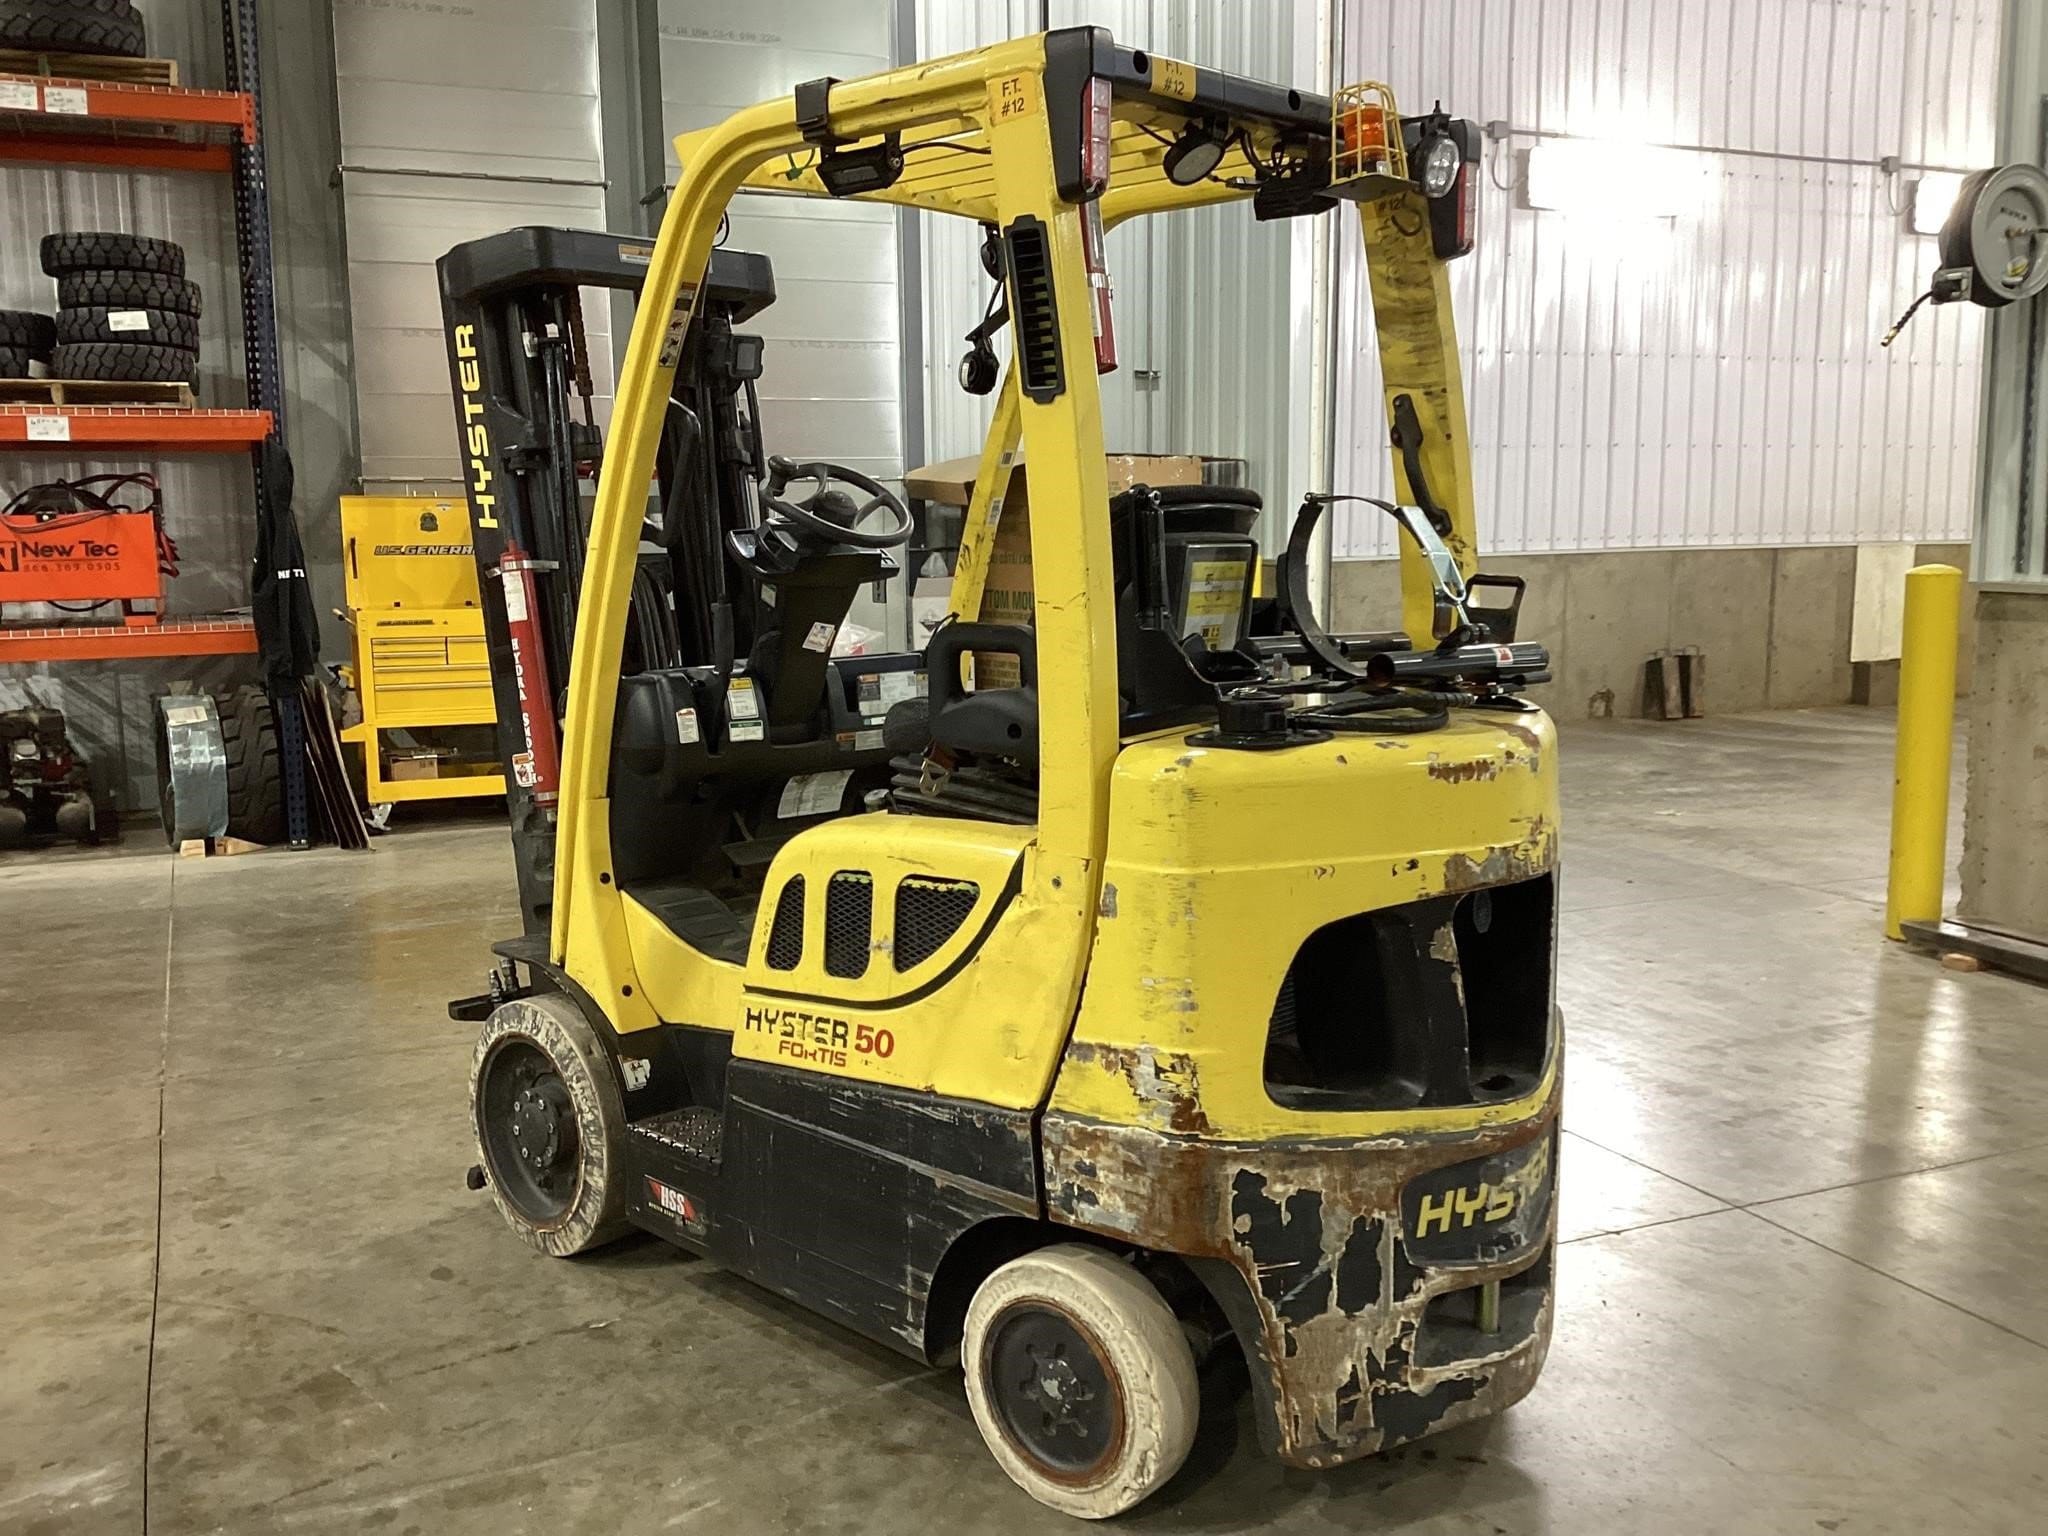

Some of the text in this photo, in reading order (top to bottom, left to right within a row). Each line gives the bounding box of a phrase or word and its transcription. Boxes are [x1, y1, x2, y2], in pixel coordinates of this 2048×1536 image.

[1002, 78, 1022, 97] F.T.
[1163, 76, 1185, 96] #12
[1001, 97, 1025, 117] #12
[455, 324, 499, 529] HYSTER
[21, 541, 75, 558] New
[79, 540, 119, 557] Tec
[403, 545, 476, 556] GENERA
[511, 638, 528, 701] HYDRA
[745, 1007, 895, 1059] HYSTER 50
[660, 1185, 685, 1215] HSS
